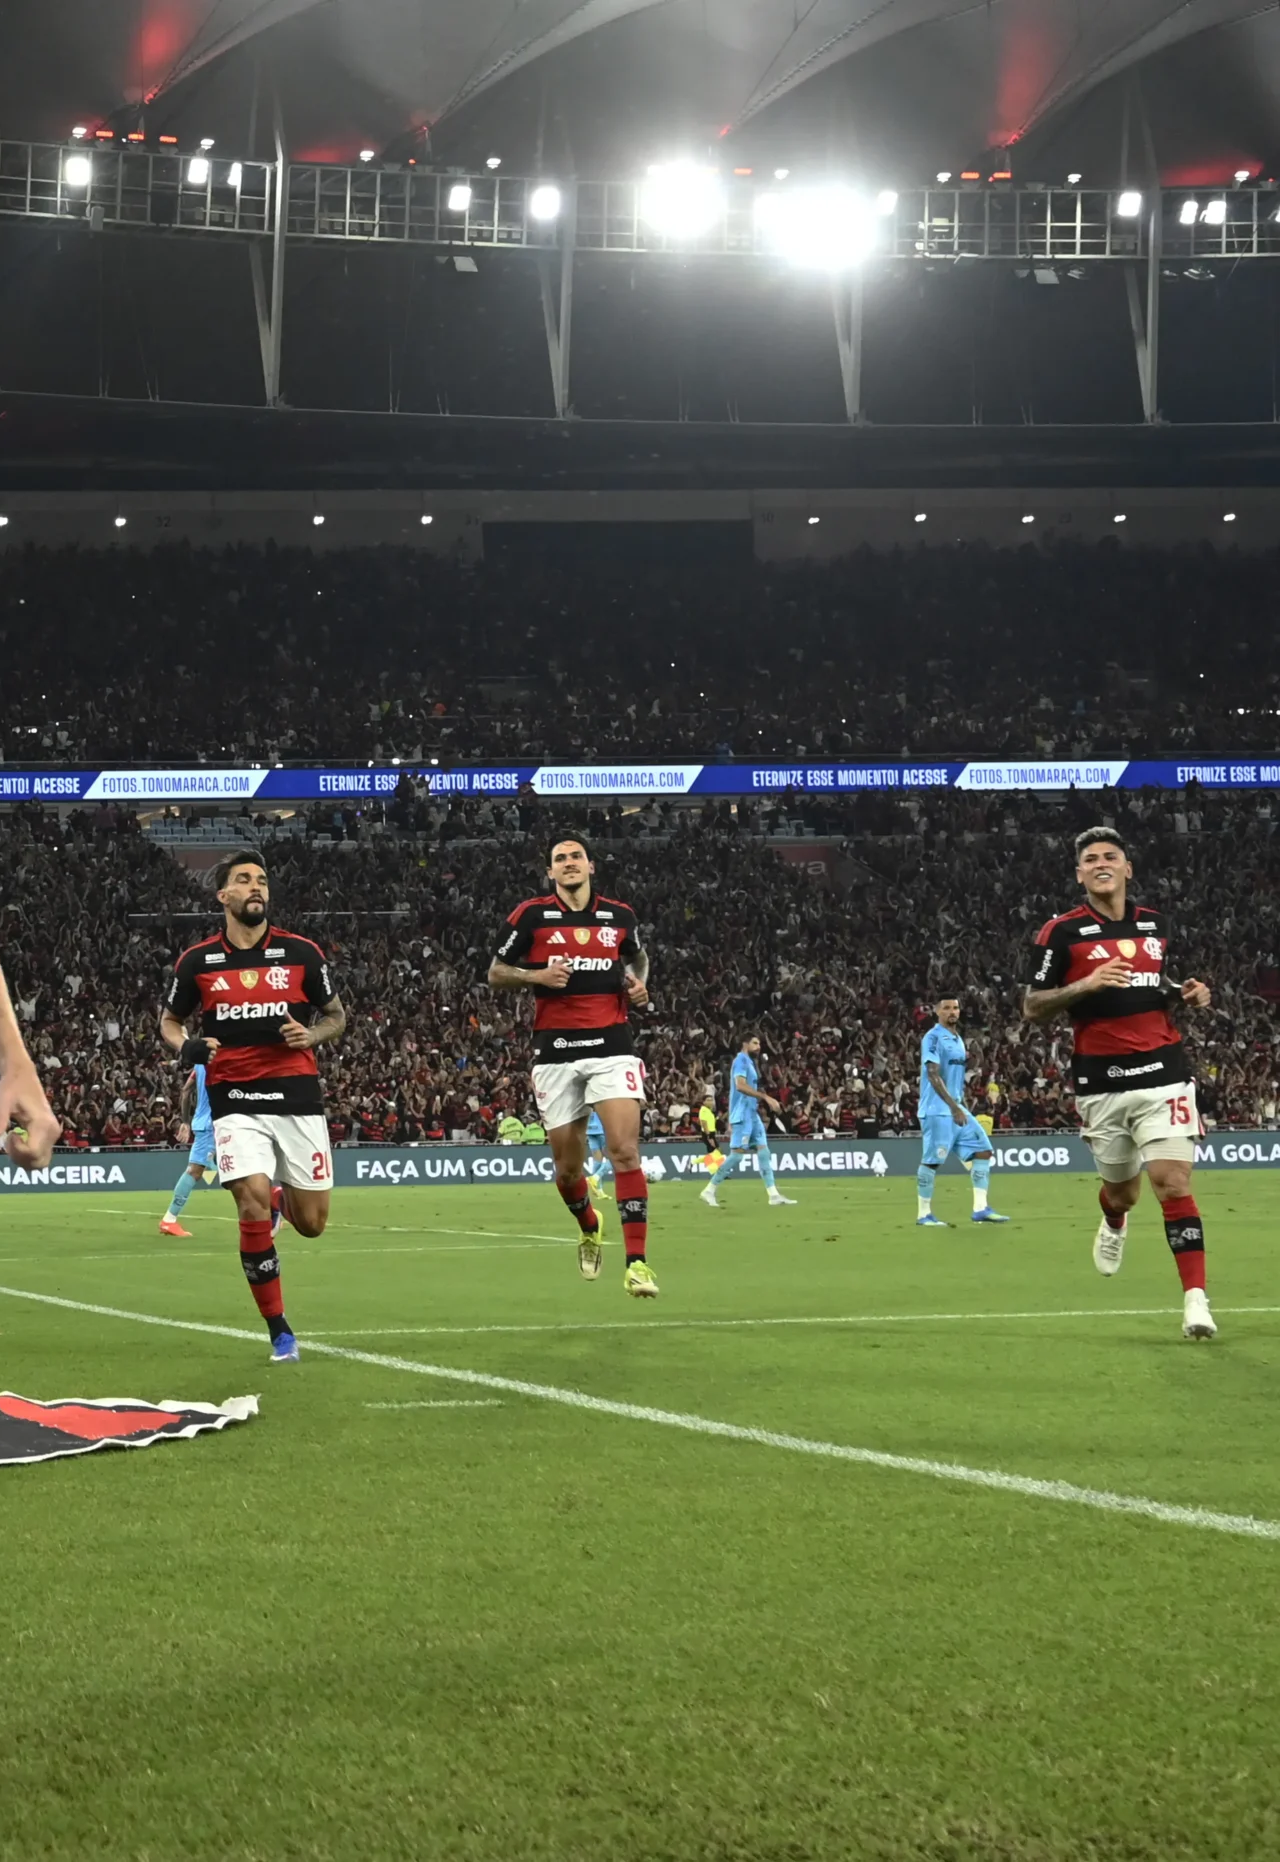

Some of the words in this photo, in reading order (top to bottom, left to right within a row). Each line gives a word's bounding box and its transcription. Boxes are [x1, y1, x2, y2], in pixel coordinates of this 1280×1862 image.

[319, 774, 371, 792] ETERNIZE
[472, 773, 519, 790] ACESSE
[752, 770, 804, 788] ETERNIZE
[807, 770, 834, 787] ESSE
[837, 769, 899, 786] MOMENTO!
[902, 768, 948, 786] ACESSE
[1176, 766, 1227, 783] ETERNIZE
[1230, 765, 1257, 783] ESSE
[1260, 765, 1280, 782] MO
[33, 777, 80, 794] ACESSE
[1034, 949, 1054, 981] Shopee
[216, 1001, 288, 1021] Betano
[625, 1071, 638, 1092] 9
[1166, 1096, 1190, 1126] 15
[356, 1160, 419, 1183] FAÇA
[424, 1159, 466, 1178] UM
[472, 1157, 554, 1181] GOLAÇ
